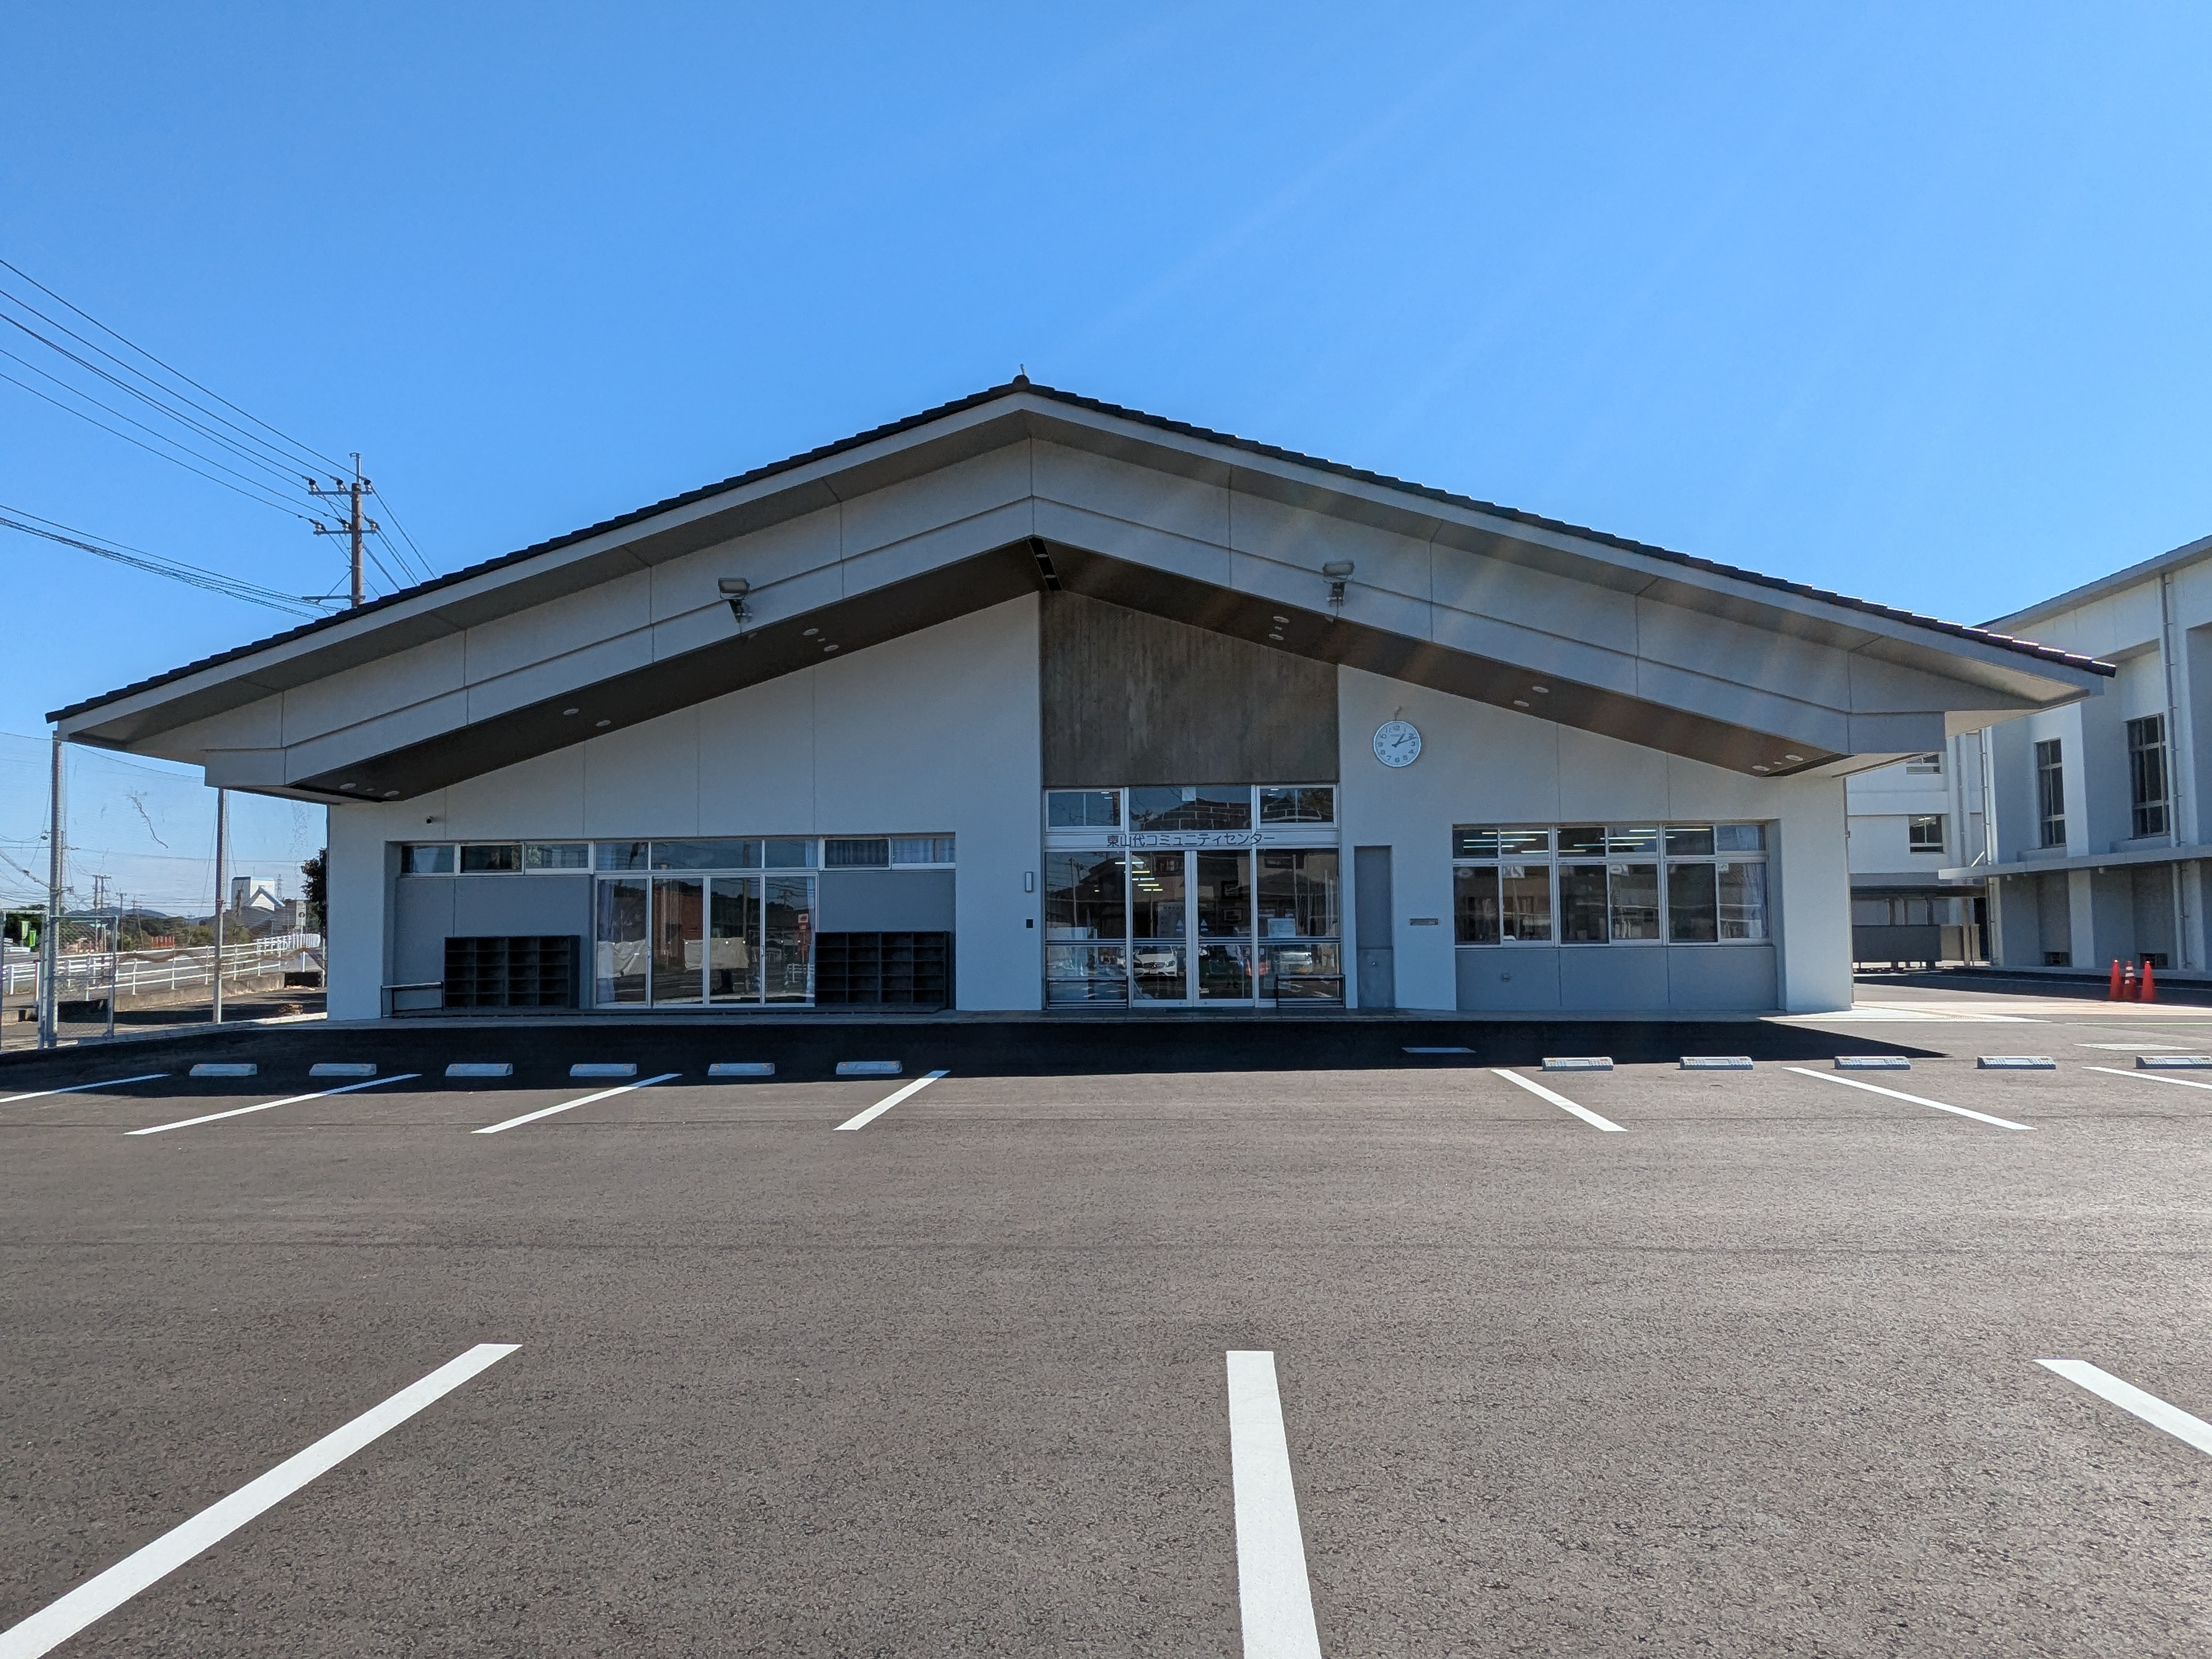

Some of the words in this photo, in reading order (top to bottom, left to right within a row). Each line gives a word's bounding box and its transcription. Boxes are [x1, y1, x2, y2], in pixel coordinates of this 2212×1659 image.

[1107, 832, 1275, 848] 東山代コミュニティセンター
